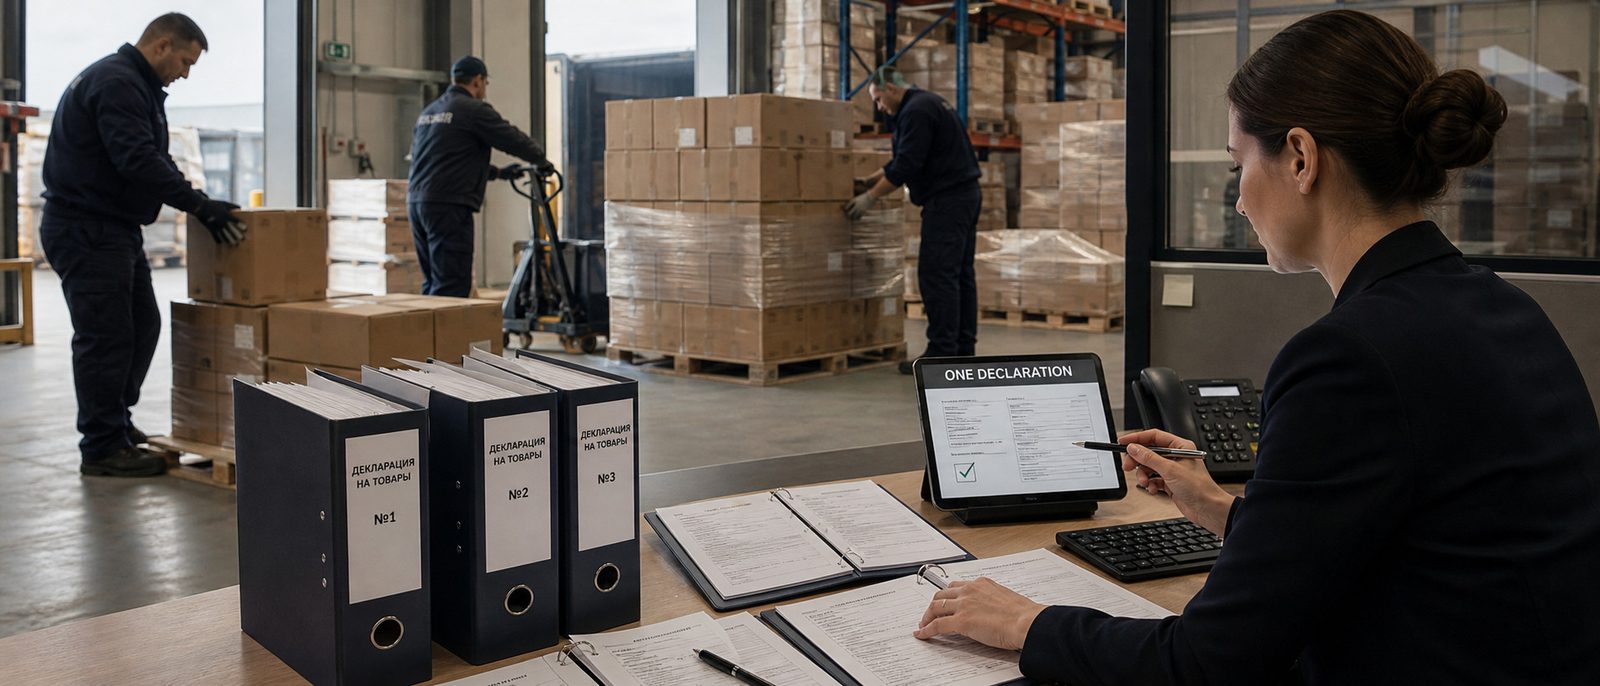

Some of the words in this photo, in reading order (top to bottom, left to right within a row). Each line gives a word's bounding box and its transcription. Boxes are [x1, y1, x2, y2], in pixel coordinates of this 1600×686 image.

[944, 368, 974, 381] ONE
[977, 365, 1073, 380] DECLARATION
[580, 424, 631, 441] ДЕКЛАРАЦИЯ
[489, 437, 546, 455] ДЕКЛАРАЦИЯ
[584, 443, 595, 451] НА
[597, 437, 628, 449] ТОВАРЫ
[493, 455, 506, 466] НА
[507, 450, 542, 464] ТОВАРЫ
[351, 458, 415, 477] ДЕКЛАРАЦИЯ
[356, 479, 370, 488] НА
[373, 472, 411, 486] ТОВАРЫ
[597, 472, 616, 484] №3
[508, 487, 529, 500] №2
[374, 511, 396, 525] №1
